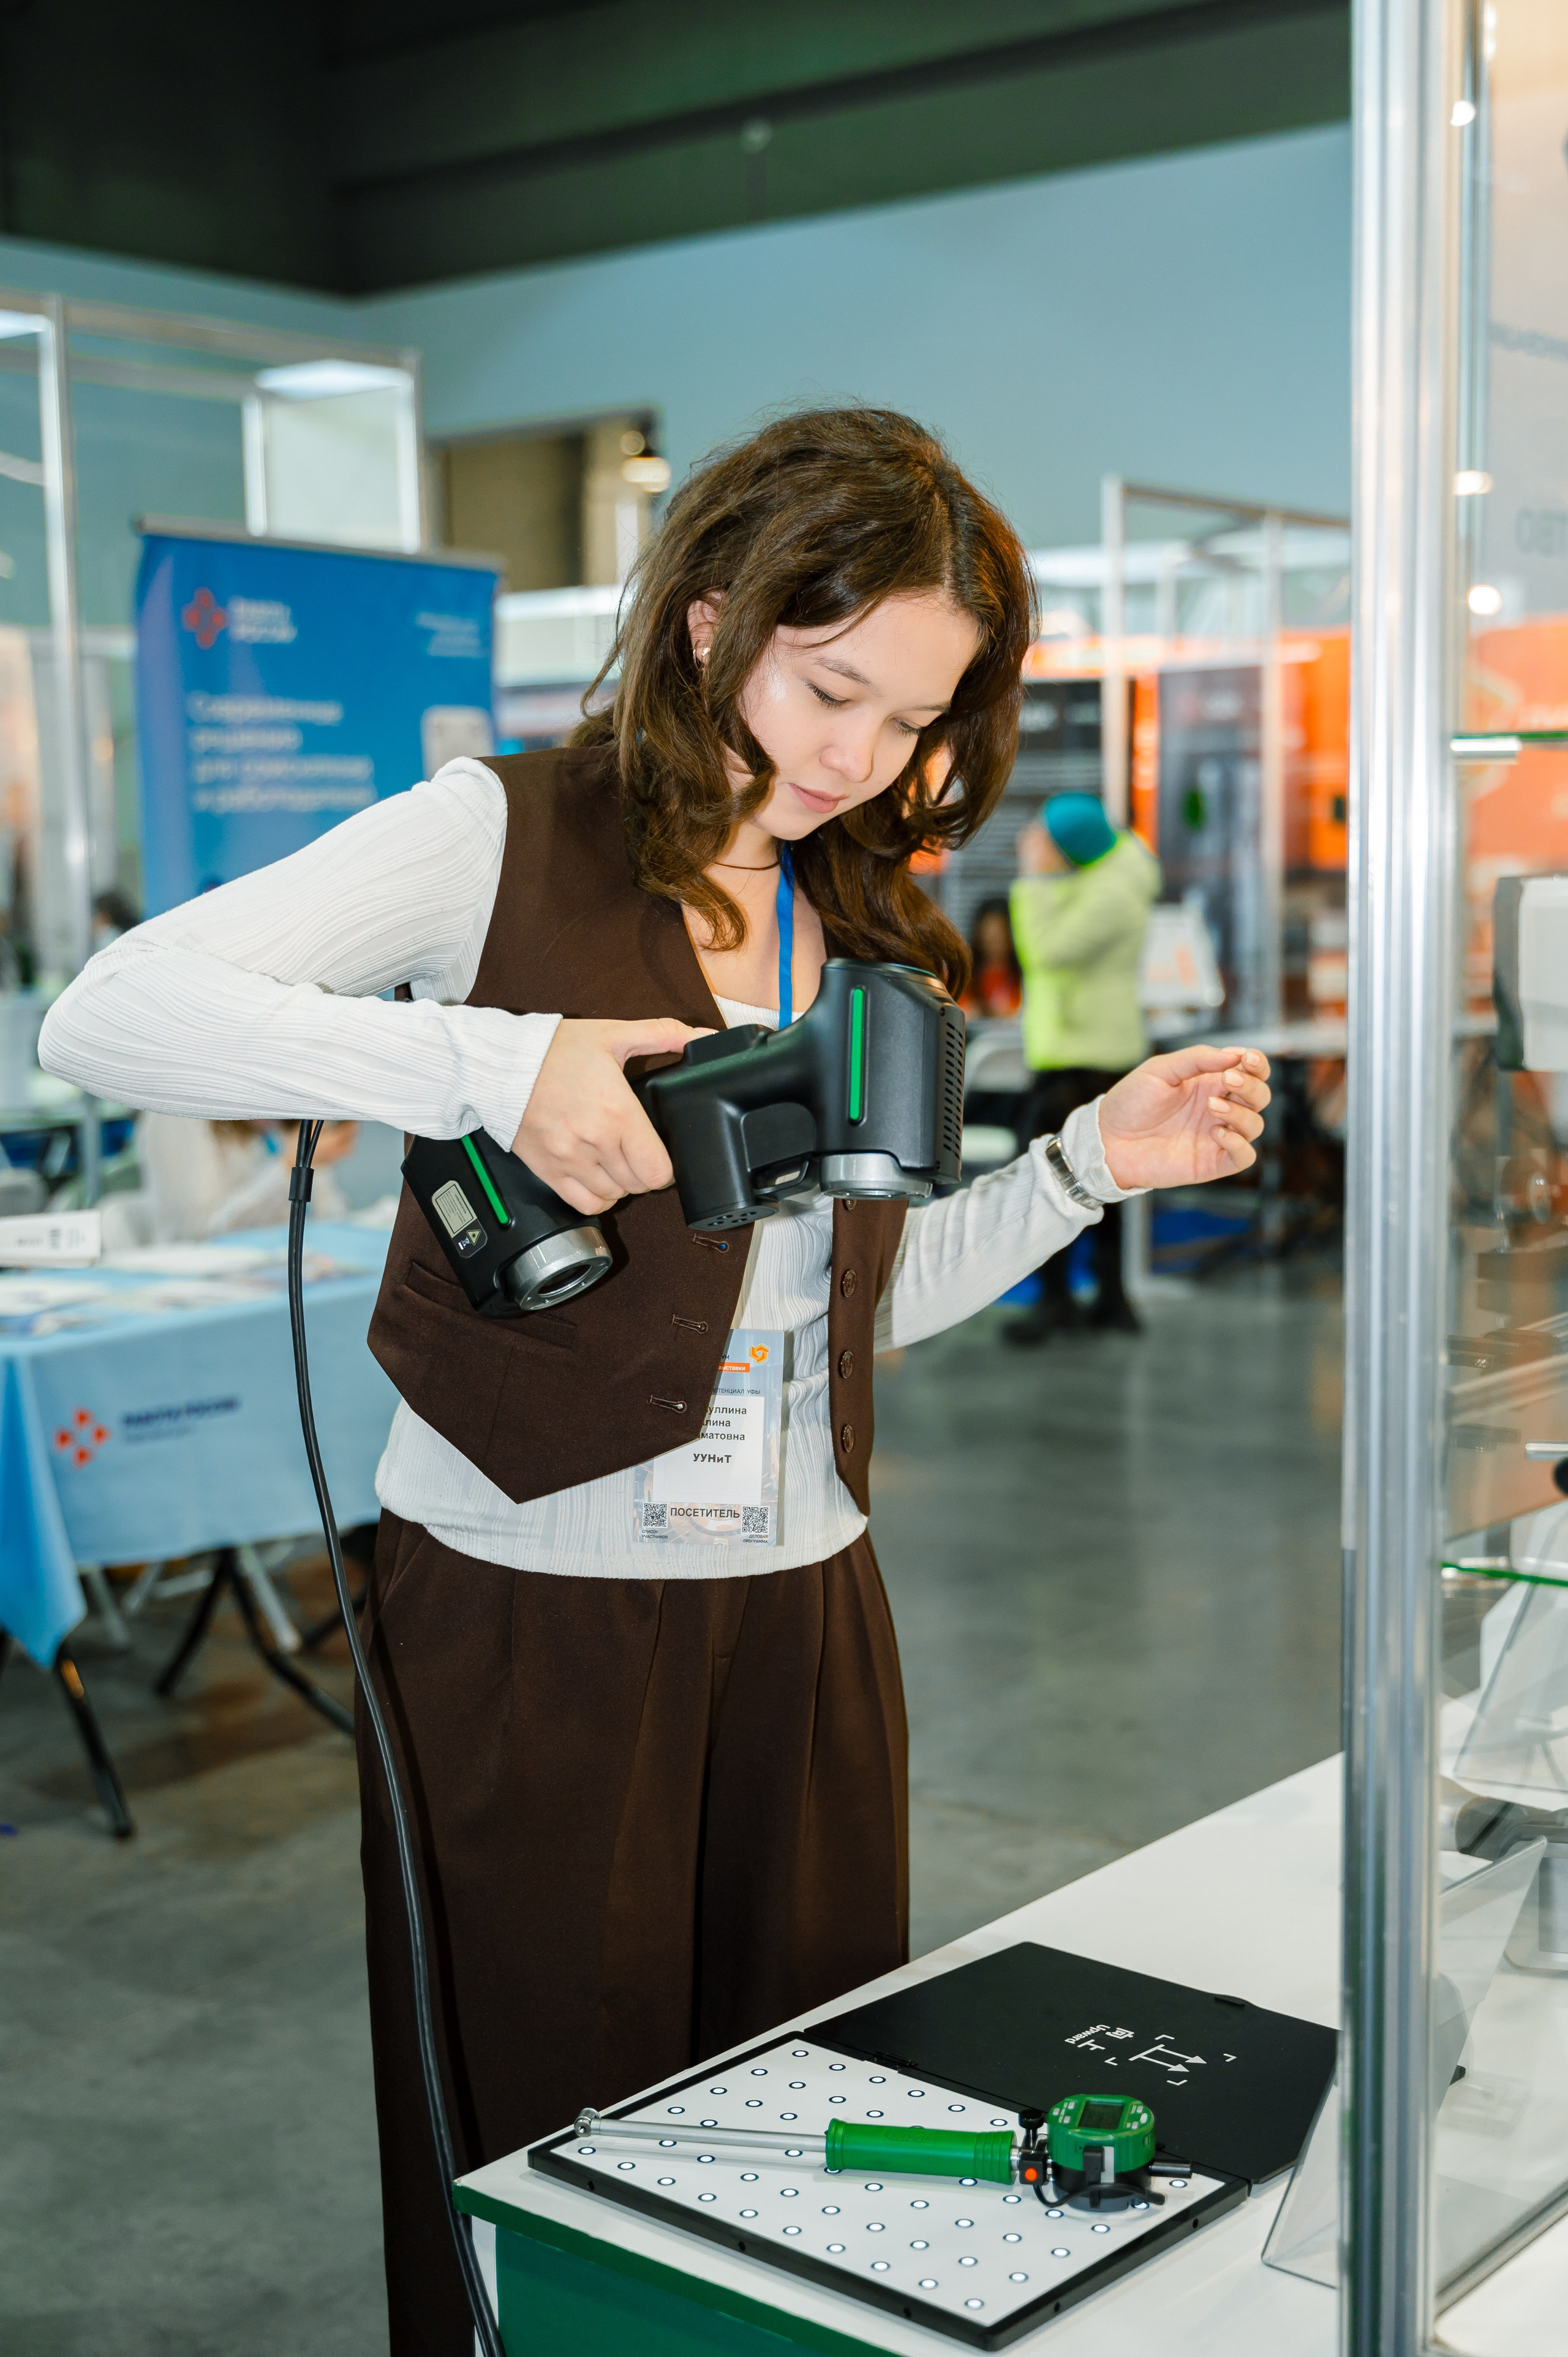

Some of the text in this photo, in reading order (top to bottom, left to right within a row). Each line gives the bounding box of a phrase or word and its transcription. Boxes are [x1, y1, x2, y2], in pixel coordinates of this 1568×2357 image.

[708, 1406, 747, 1416] уллина
[699, 1432, 745, 1441] матовна
[693, 1453, 732, 1463] УУНиТ
[670, 1507, 740, 1518] ПОСЕТИТЕЛЬ
[1065, 2024, 1110, 2045] Upward
